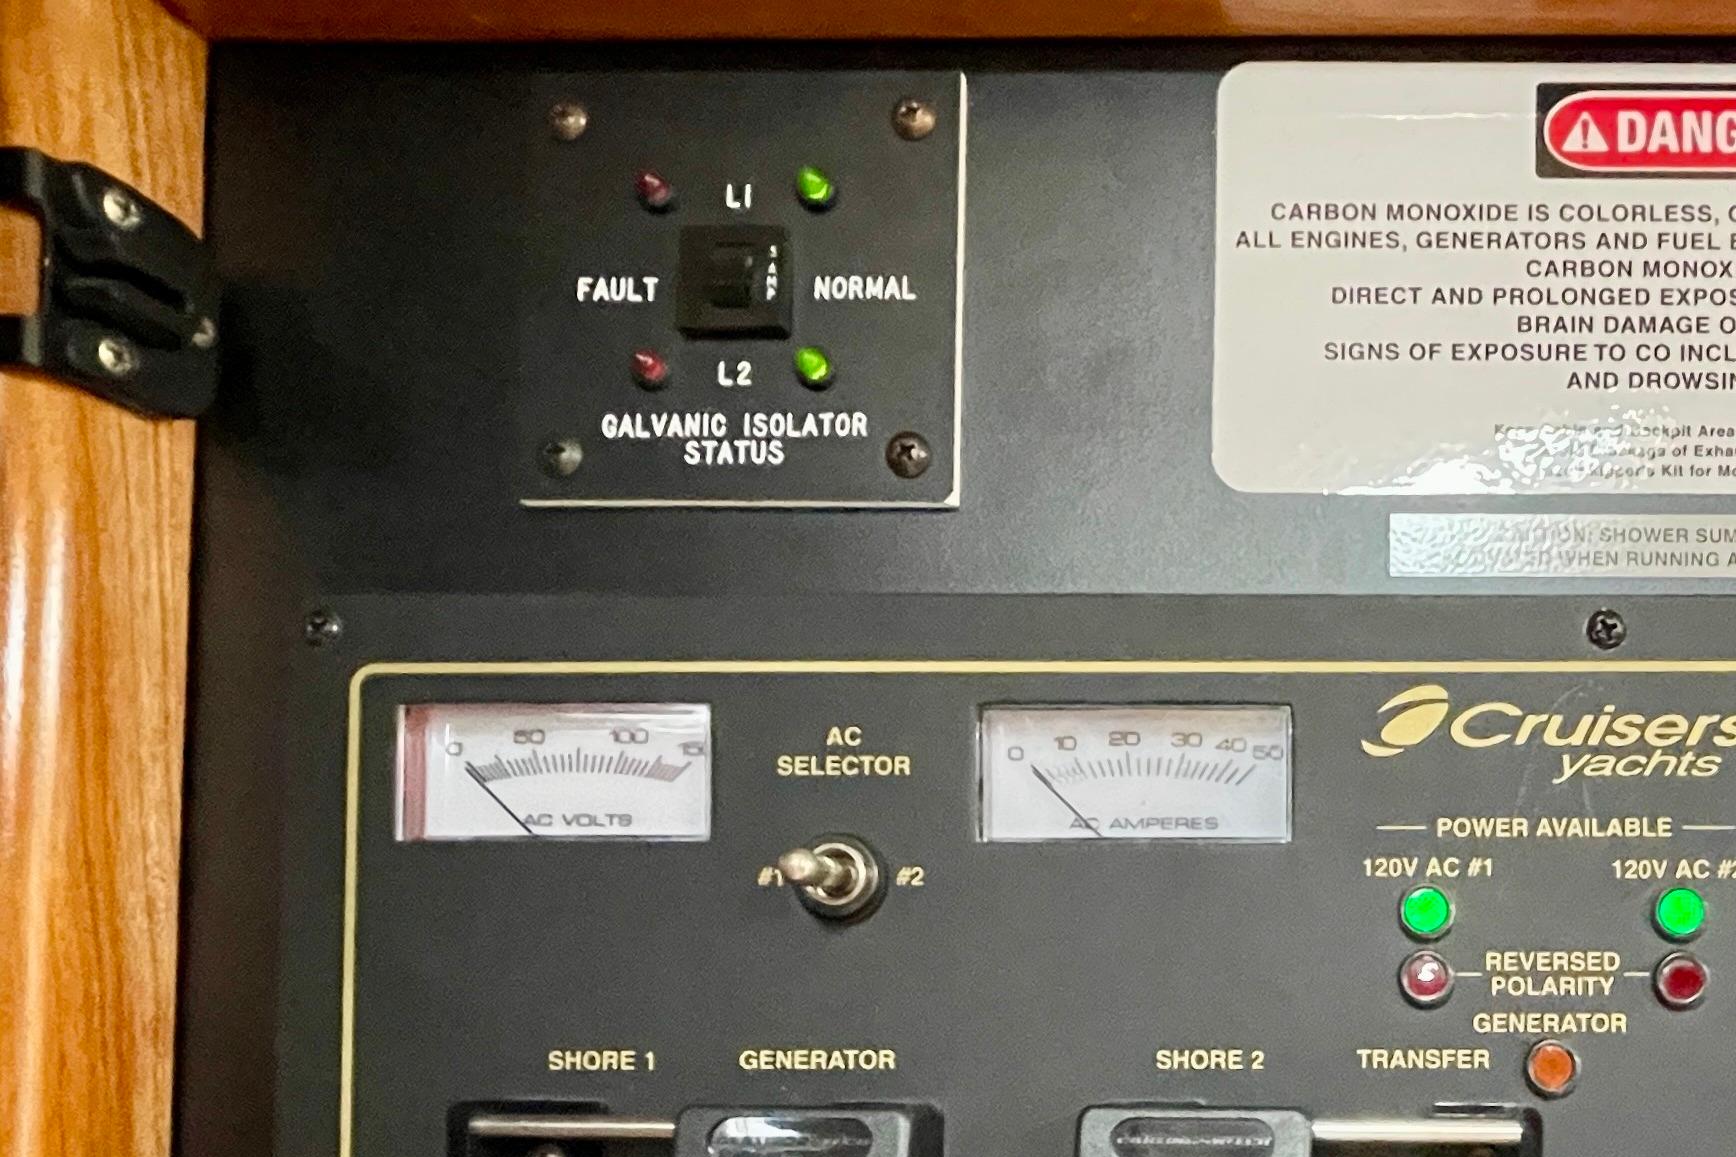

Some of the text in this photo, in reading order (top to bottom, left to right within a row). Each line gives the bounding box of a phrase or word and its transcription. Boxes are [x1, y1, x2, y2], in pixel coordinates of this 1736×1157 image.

[1270, 202, 1377, 221] CARBON
[1386, 203, 1518, 222] MONOXIDE
[1527, 203, 1550, 222] IS
[1559, 203, 1719, 226] COLORLESS,
[1235, 230, 1280, 248] ALL
[1291, 230, 1407, 252] ENGINES,
[1415, 231, 1586, 250] GENERATORS
[1596, 232, 1648, 250] AND
[1657, 232, 1721, 251] FUEL
[1526, 259, 1633, 278] CARBON
[576, 276, 659, 303] FAULT
[813, 275, 917, 301] NORMAL
[1331, 286, 1422, 305] DIRECT
[1431, 287, 1483, 305] AND
[1492, 287, 1651, 306] PROLONGED
[1517, 315, 1594, 334] BRAIN
[1604, 315, 1710, 334] DAMAGE
[1324, 342, 1400, 361] SIGNS
[1408, 342, 1442, 361] OF
[1451, 343, 1587, 362] EXPOSURE
[1593, 343, 1626, 362] TO
[1635, 343, 1671, 362] CO
[717, 360, 752, 387] L2
[1566, 371, 1619, 390] AND
[601, 411, 868, 439] GALVANIC ISOLATOR
[683, 439, 785, 466] STATUS
[1671, 444, 1688, 458] of
[1661, 464, 1684, 477] Kit
[1689, 464, 1712, 477] for
[1599, 527, 1689, 543] SHOWER
[1626, 550, 1720, 567] RUNNING
[826, 726, 862, 747] AC
[777, 755, 911, 776] SELECTOR
[1552, 749, 1723, 785] yachts
[1437, 816, 1673, 838] POWER AVAILABLE
[896, 866, 925, 886] #2
[1363, 856, 1492, 878] 120V AC #1
[1611, 859, 1668, 880] 120V
[1675, 858, 1710, 879] AC
[1485, 951, 1621, 972] REVERSED
[1491, 975, 1615, 997] POLARITY
[1473, 1012, 1627, 1034] GENERATOR
[548, 1050, 655, 1071] SHORE 1
[739, 1049, 896, 1070] GENERATOR
[1156, 1049, 1265, 1070] SHORE 2
[1356, 1048, 1490, 1069] TRANSFER
